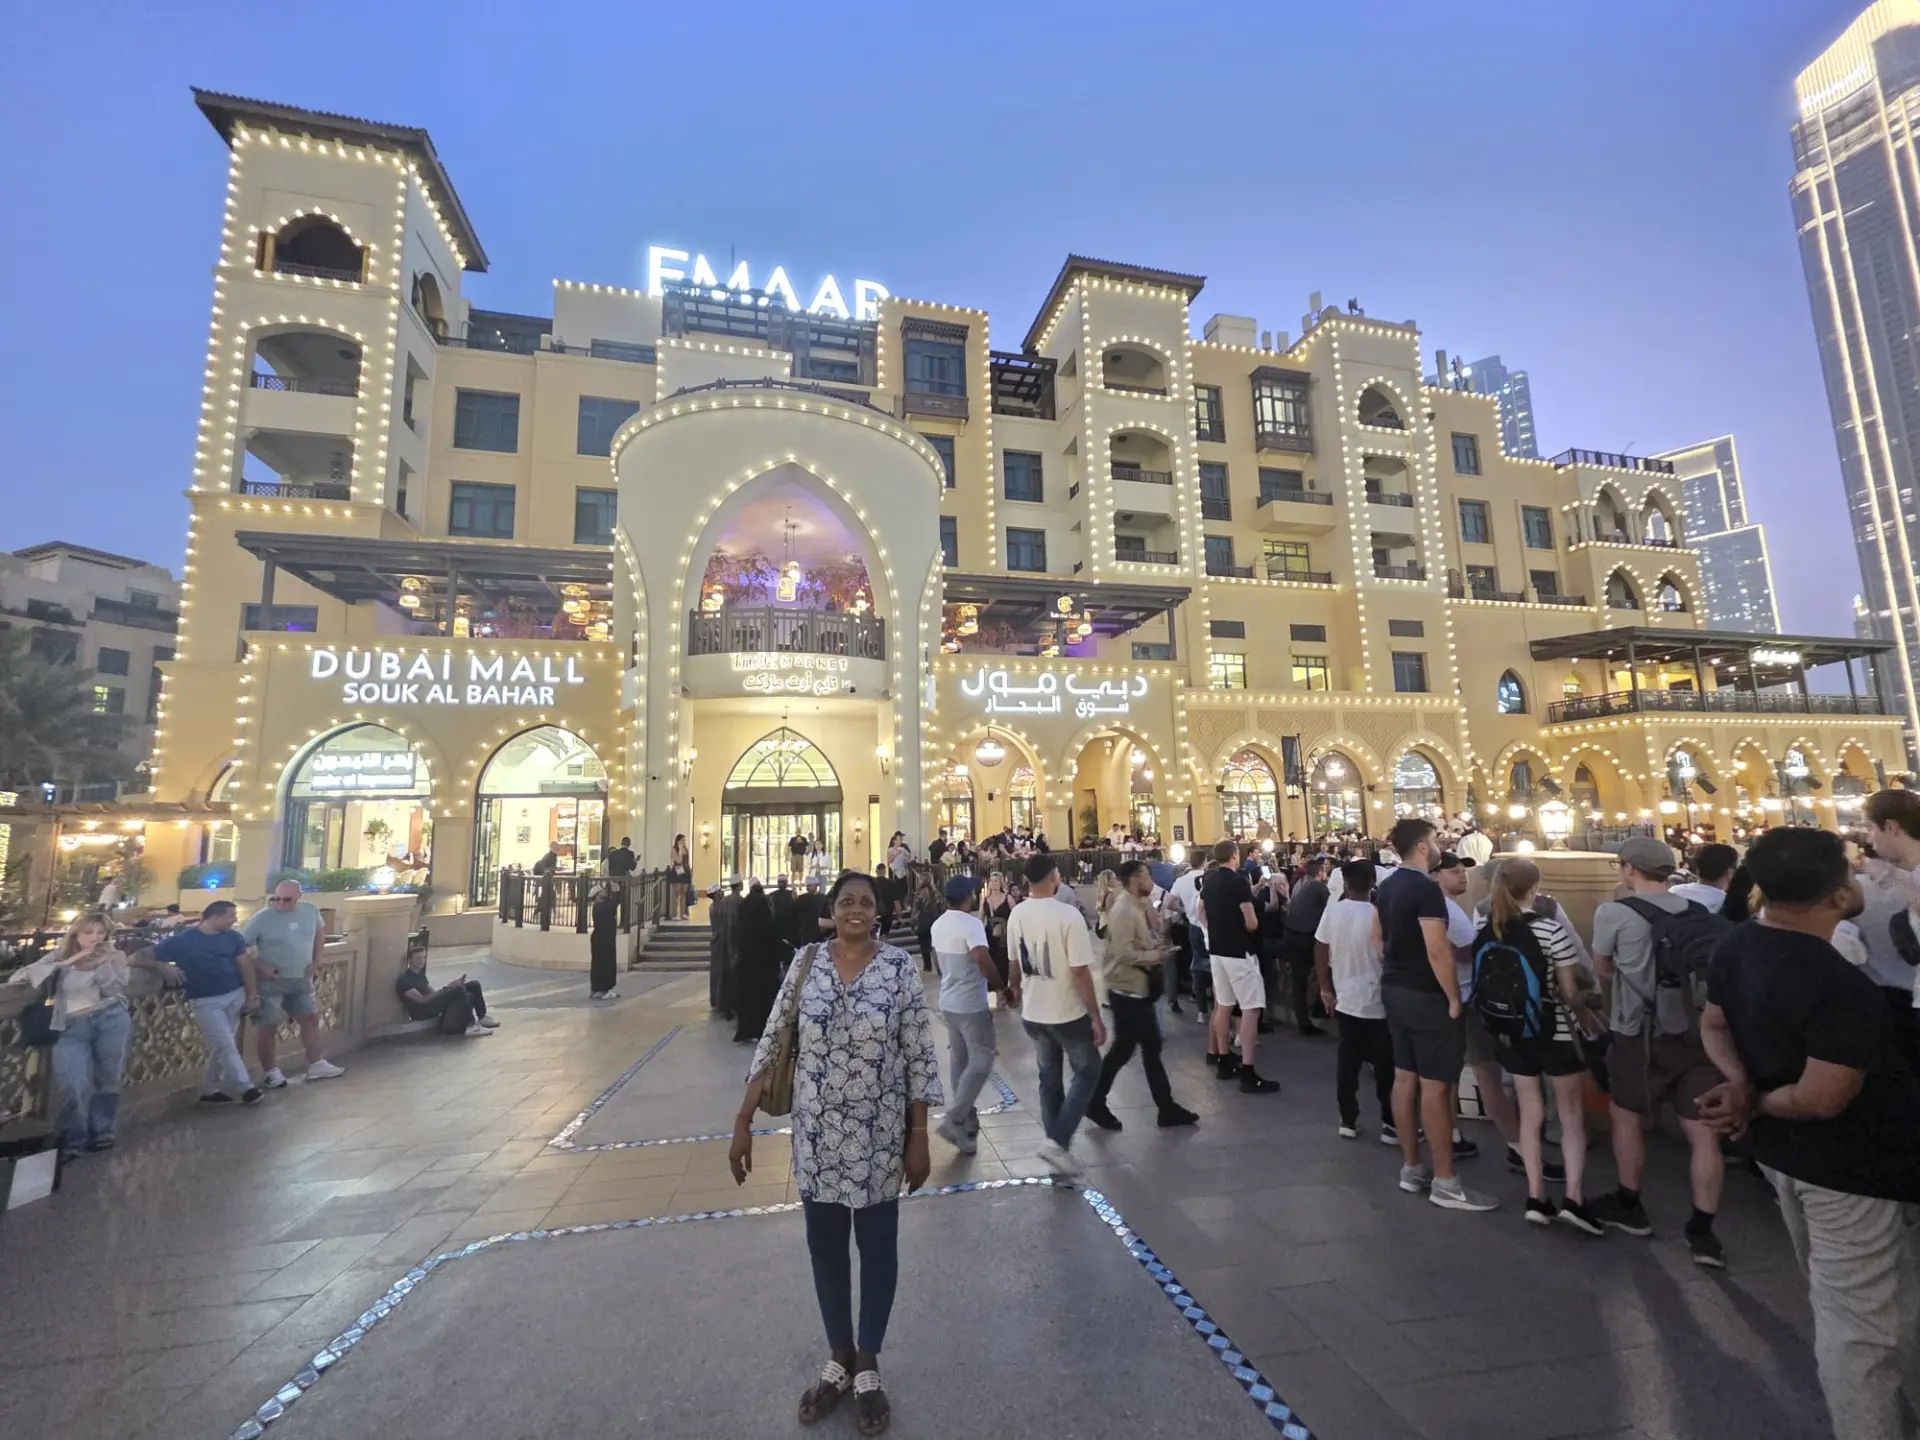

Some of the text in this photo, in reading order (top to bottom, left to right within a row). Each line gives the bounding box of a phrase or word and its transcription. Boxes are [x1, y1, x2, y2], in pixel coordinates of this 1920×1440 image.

[648, 245, 890, 322] EMAAR
[311, 650, 584, 683] DUBAI MALL
[343, 683, 555, 706] SOUK AL BAHAR
[1065, 672, 1148, 699] دبي
[1075, 698, 1130, 718] سوق
